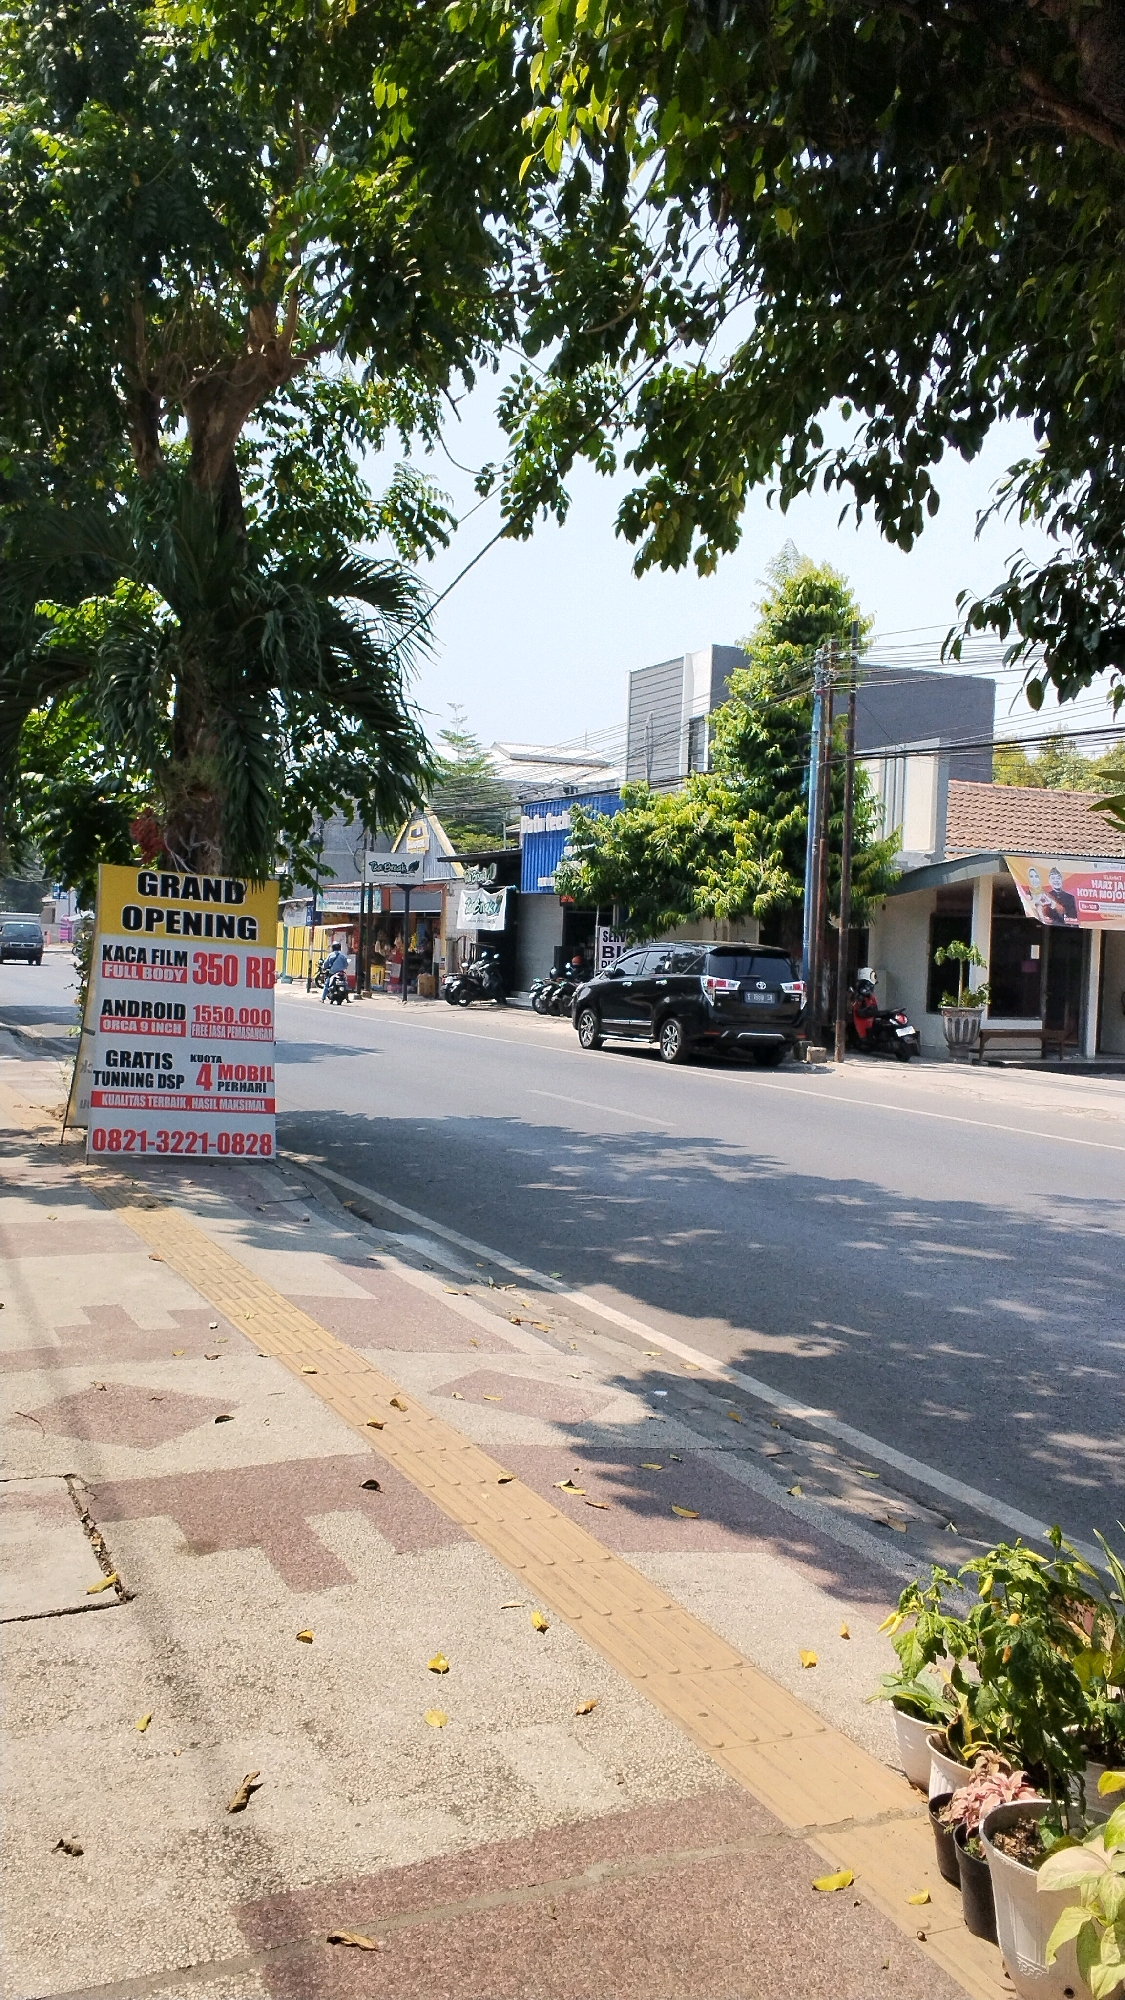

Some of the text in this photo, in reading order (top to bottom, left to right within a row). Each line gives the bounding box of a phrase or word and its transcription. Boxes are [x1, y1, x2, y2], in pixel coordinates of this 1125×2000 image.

[383, 861, 408, 875] Break
[137, 871, 246, 905] GRAND
[1077, 888, 1097, 898] KOTA
[122, 905, 258, 941] OPENING
[102, 944, 277, 989] KACA FILM 350 RB
[104, 964, 184, 982] FULL BODY
[101, 999, 271, 1025] ANDROID 1550.000
[103, 1019, 181, 1034] ORCA 9 INCH
[191, 1024, 208, 1037] FREE
[227, 1026, 273, 1041] PEMASANGAN
[105, 1050, 173, 1070] GRATIS
[190, 1054, 223, 1063] KUOTA
[93, 1070, 184, 1089] TUNNING DSP
[196, 1064, 274, 1091] 4 MOBIL
[217, 1081, 267, 1093] PERHARI
[102, 1094, 146, 1107] KUALITAS
[192, 1097, 218, 1109] HASIL
[220, 1098, 266, 1111] MAKSIMAL
[92, 1128, 272, 1156] 0821-3221-0828
